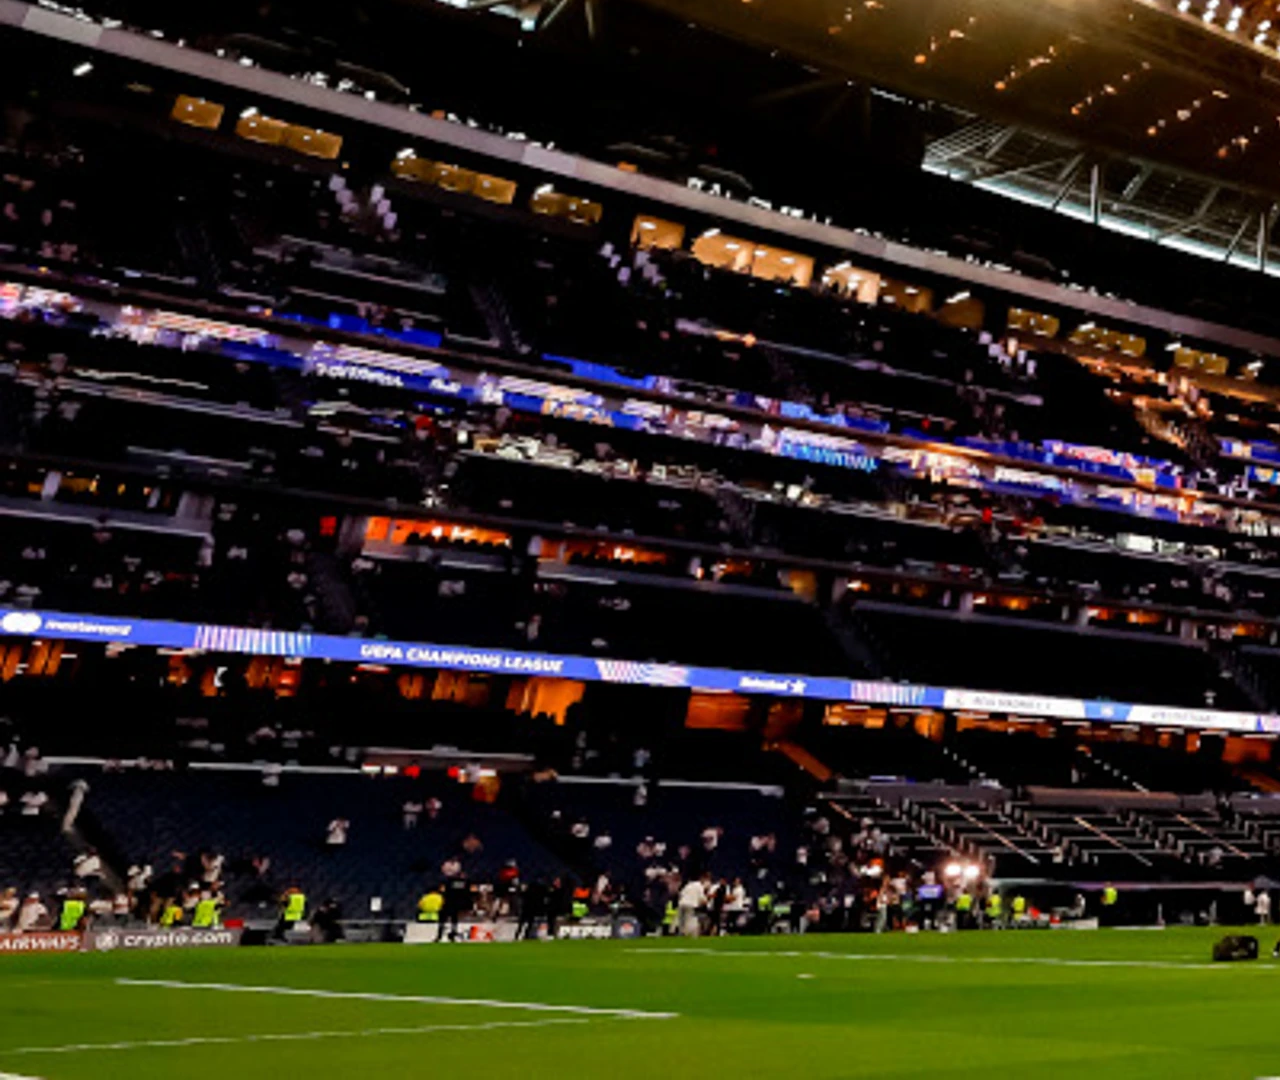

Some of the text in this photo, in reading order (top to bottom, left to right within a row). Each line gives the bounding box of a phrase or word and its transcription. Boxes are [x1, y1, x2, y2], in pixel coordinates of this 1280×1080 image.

[360, 644, 564, 672] UEFA CHAMPIONS LEAGUE
[124, 931, 232, 948] crypto.com
